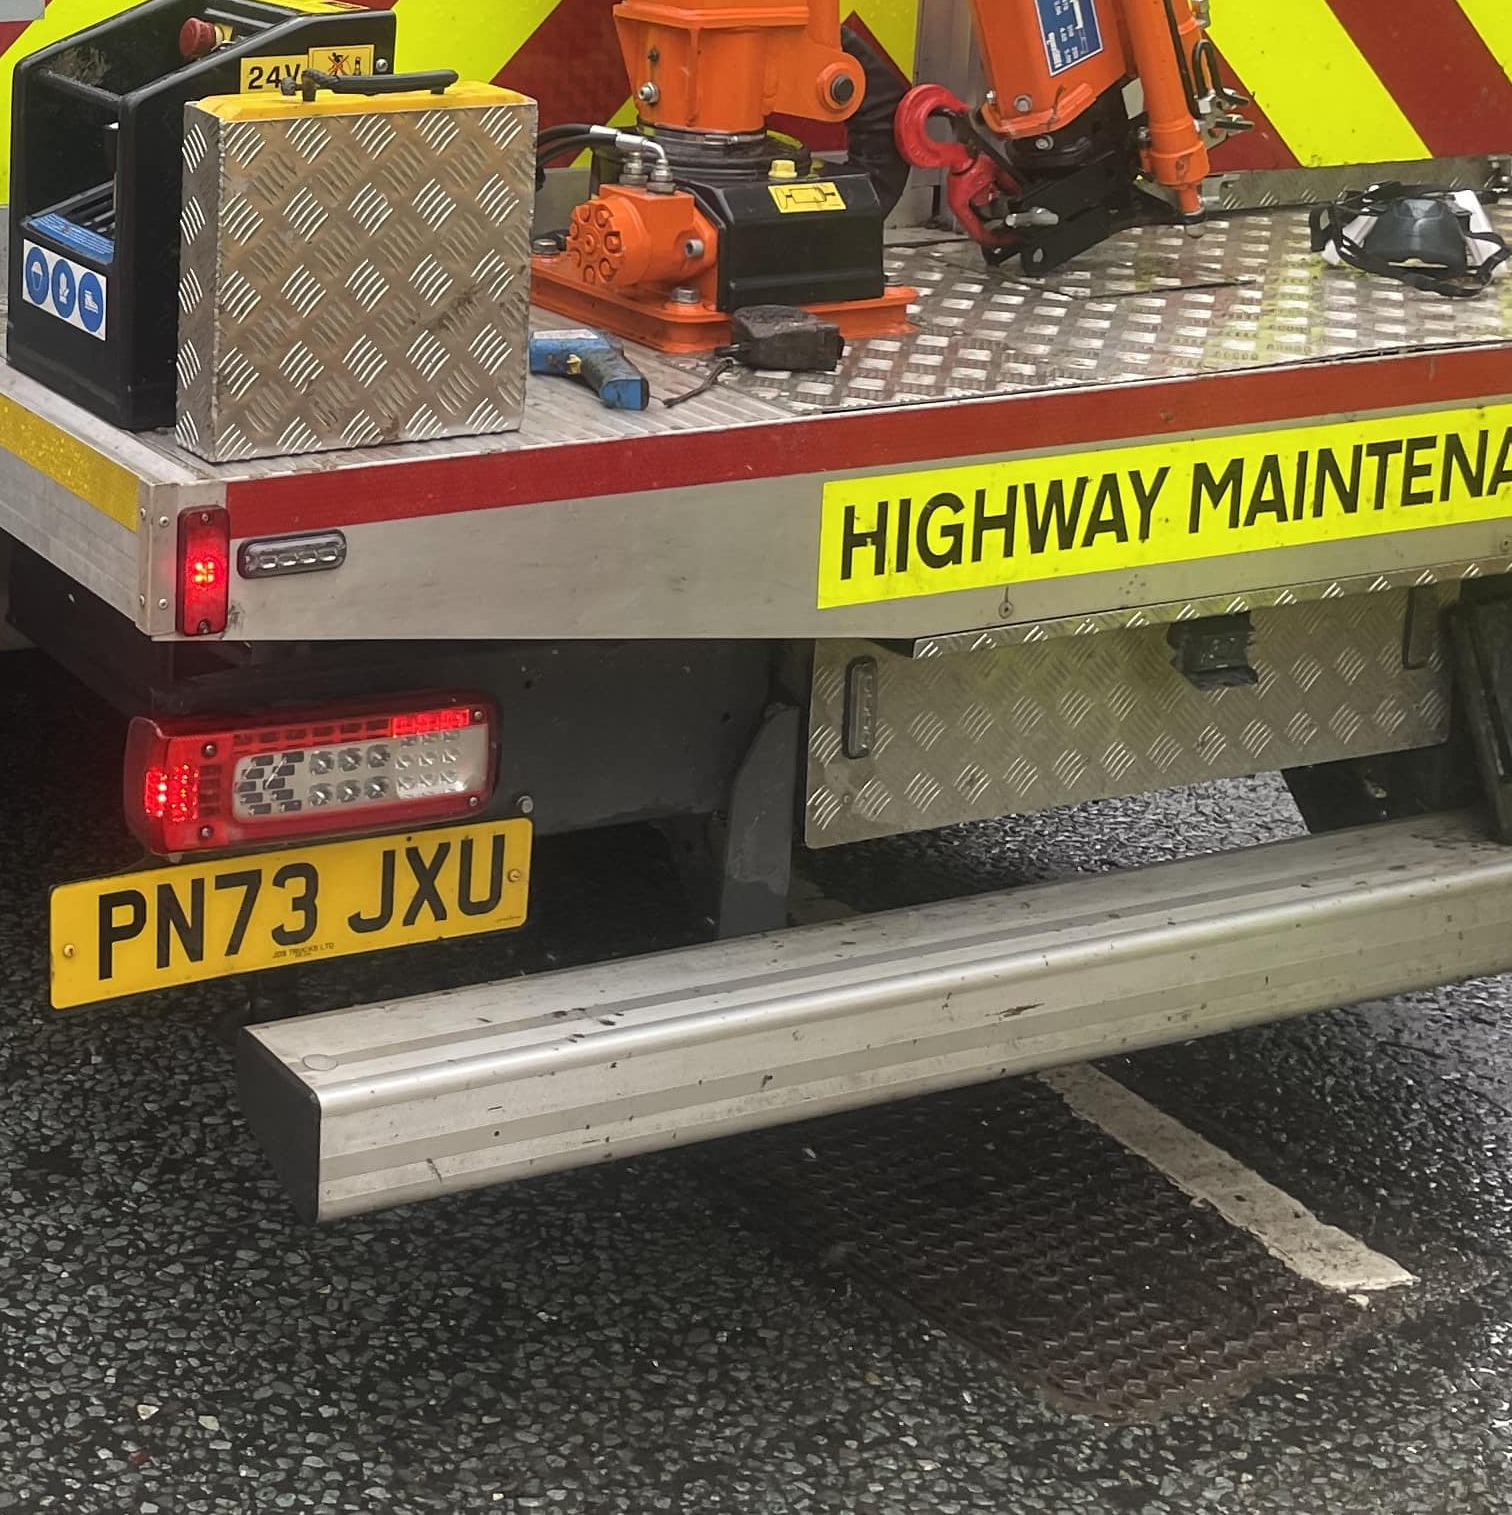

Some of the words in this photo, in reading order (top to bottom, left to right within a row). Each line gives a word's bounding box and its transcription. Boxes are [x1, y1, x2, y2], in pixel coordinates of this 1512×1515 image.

[247, 63, 301, 90] 24V
[840, 466, 1172, 581] HIGHWAY
[98, 861, 320, 981] PN73
[347, 833, 506, 935] JXU
[320, 942, 335, 951] LTD
